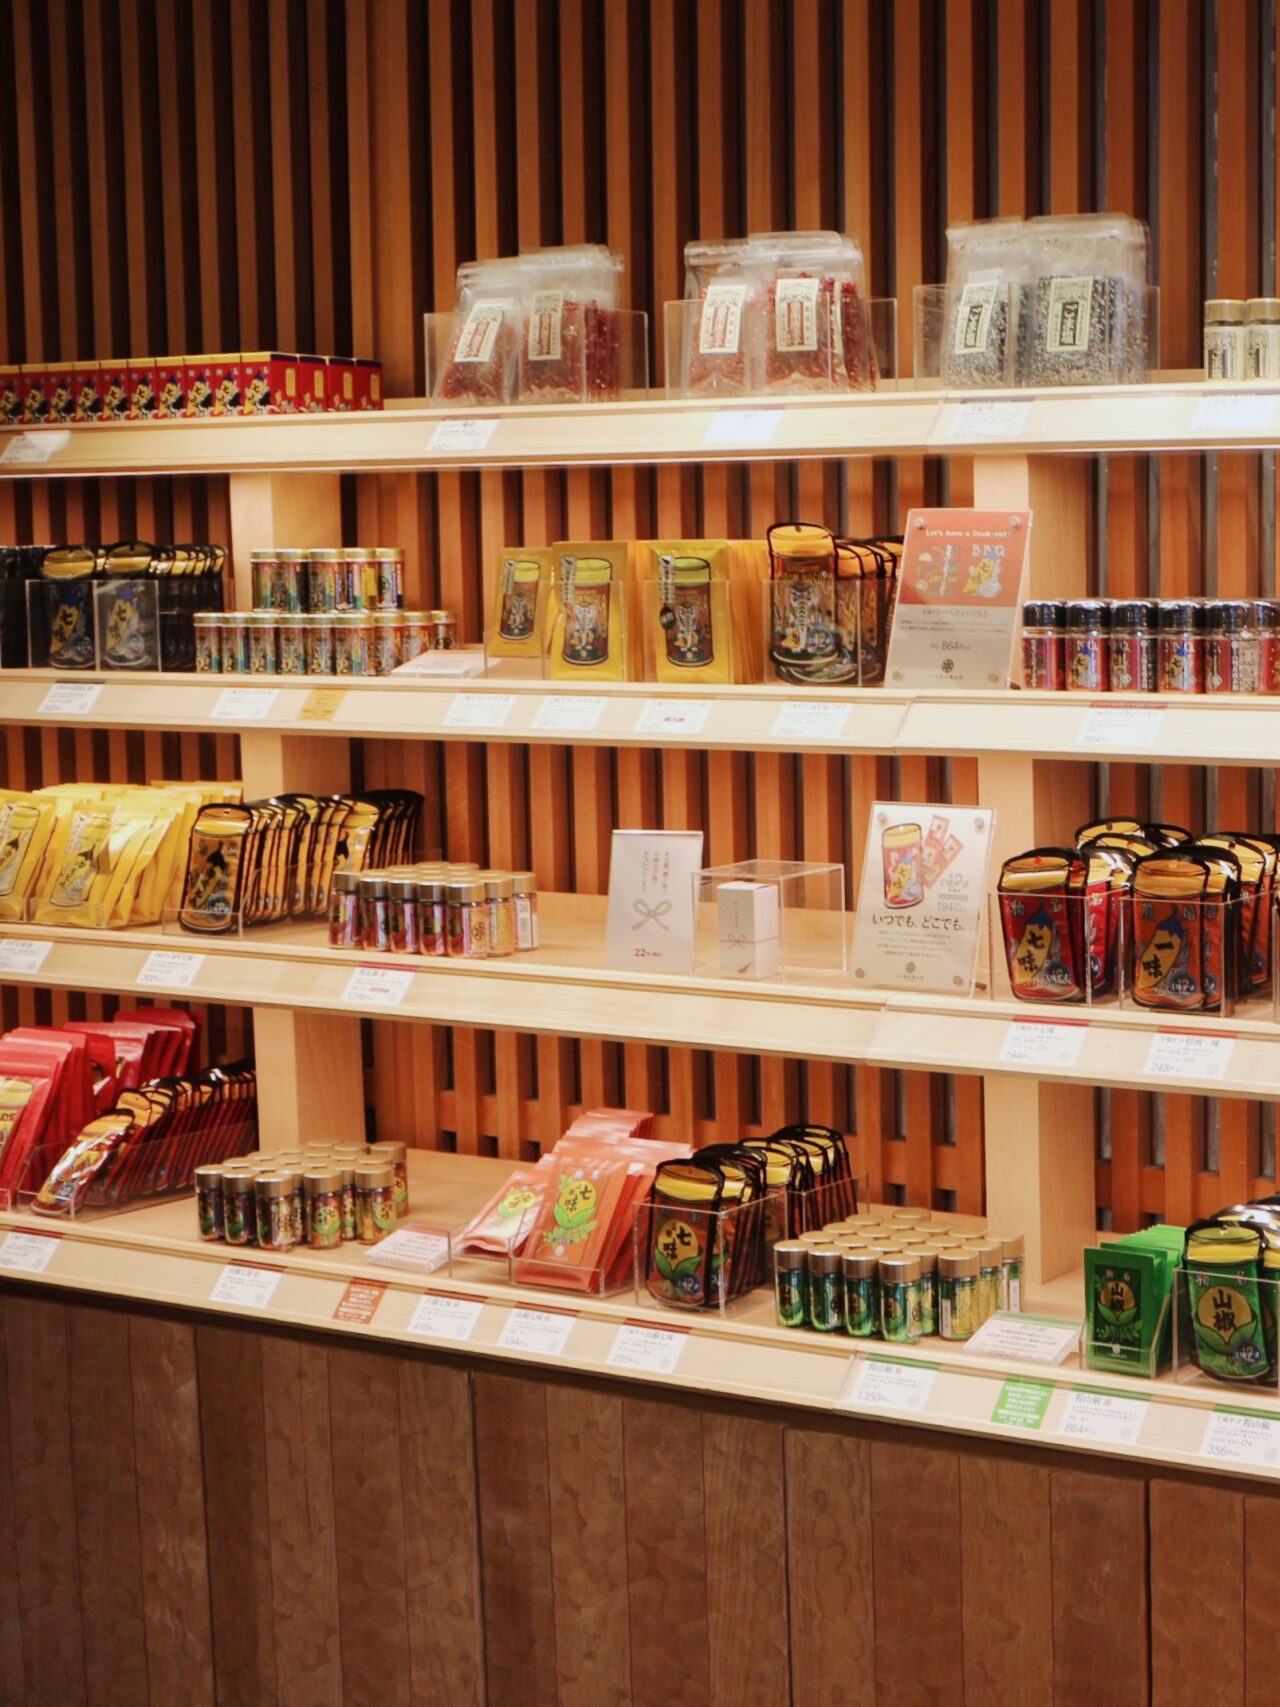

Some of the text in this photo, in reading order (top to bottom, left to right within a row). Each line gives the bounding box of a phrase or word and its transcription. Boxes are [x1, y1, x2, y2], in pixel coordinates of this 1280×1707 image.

[925, 529, 943, 537] Let's
[972, 544, 1006, 557] BBQ
[1018, 930, 1045, 974] 七味
[1142, 942, 1174, 979] 一味
[563, 1184, 593, 1213] 七味
[663, 1225, 691, 1261] 七味
[1212, 1289, 1237, 1333] 山椒
